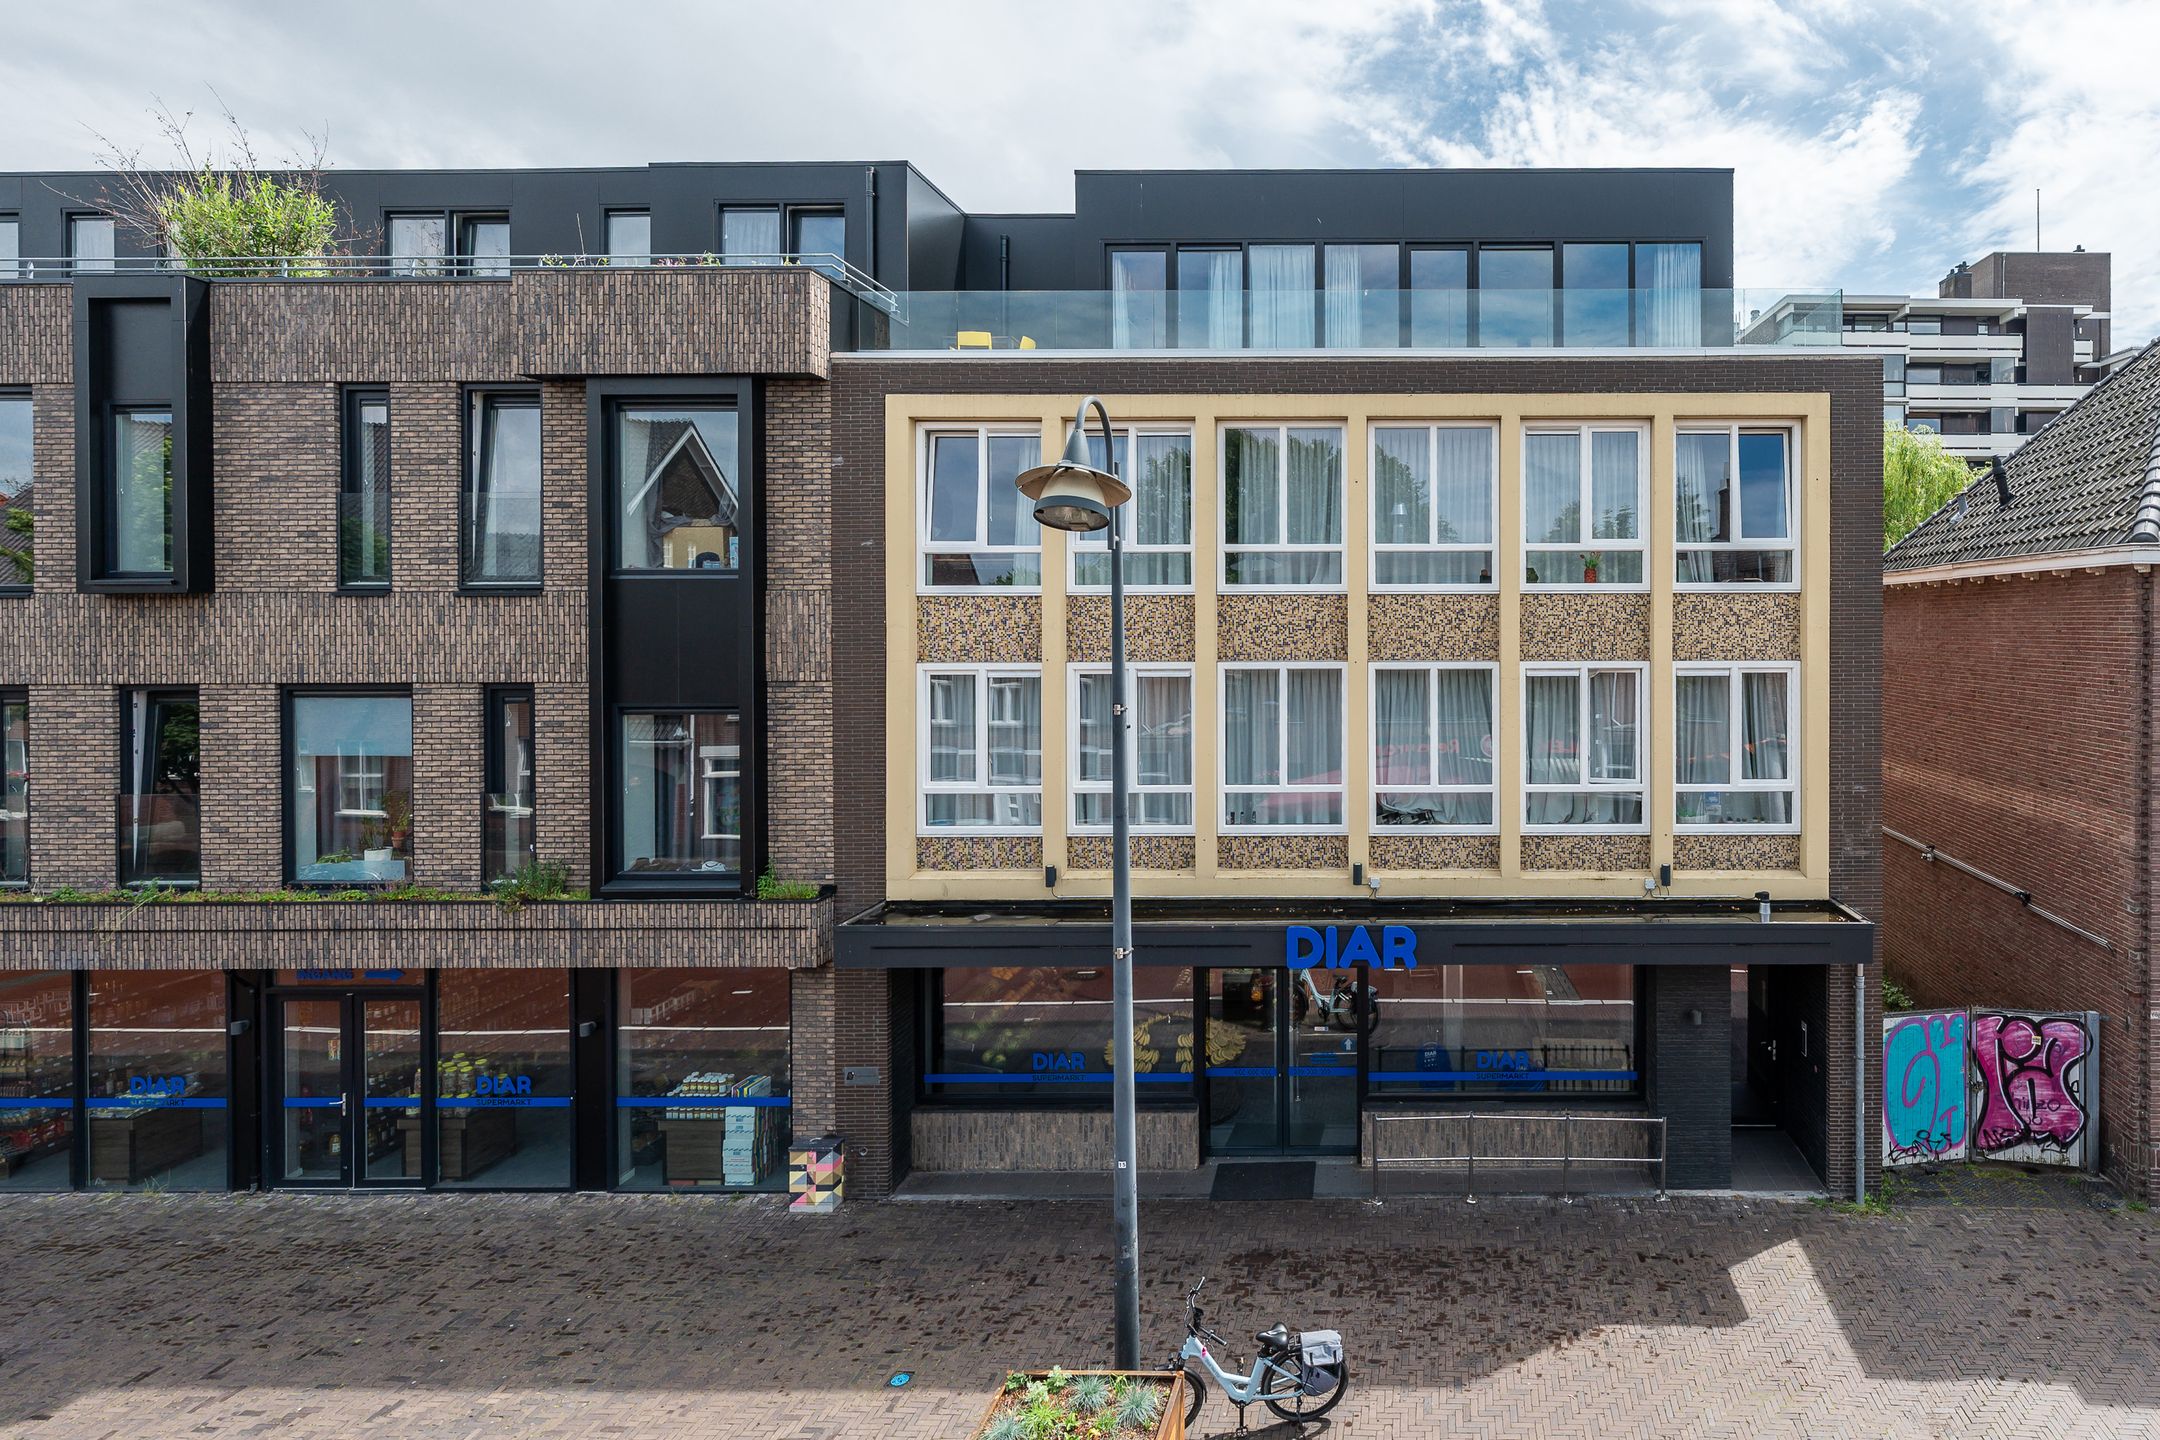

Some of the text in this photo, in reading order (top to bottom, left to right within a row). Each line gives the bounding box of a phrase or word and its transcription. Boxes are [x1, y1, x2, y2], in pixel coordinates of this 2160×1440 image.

[1286, 925, 1418, 969] DIAR
[1032, 1052, 1086, 1071] DIAR
[1476, 1051, 1529, 1070] DIAR
[130, 1076, 186, 1096] DIAR
[476, 1076, 532, 1095] DIAR
[476, 1098, 532, 1106] SUPERMARKT
